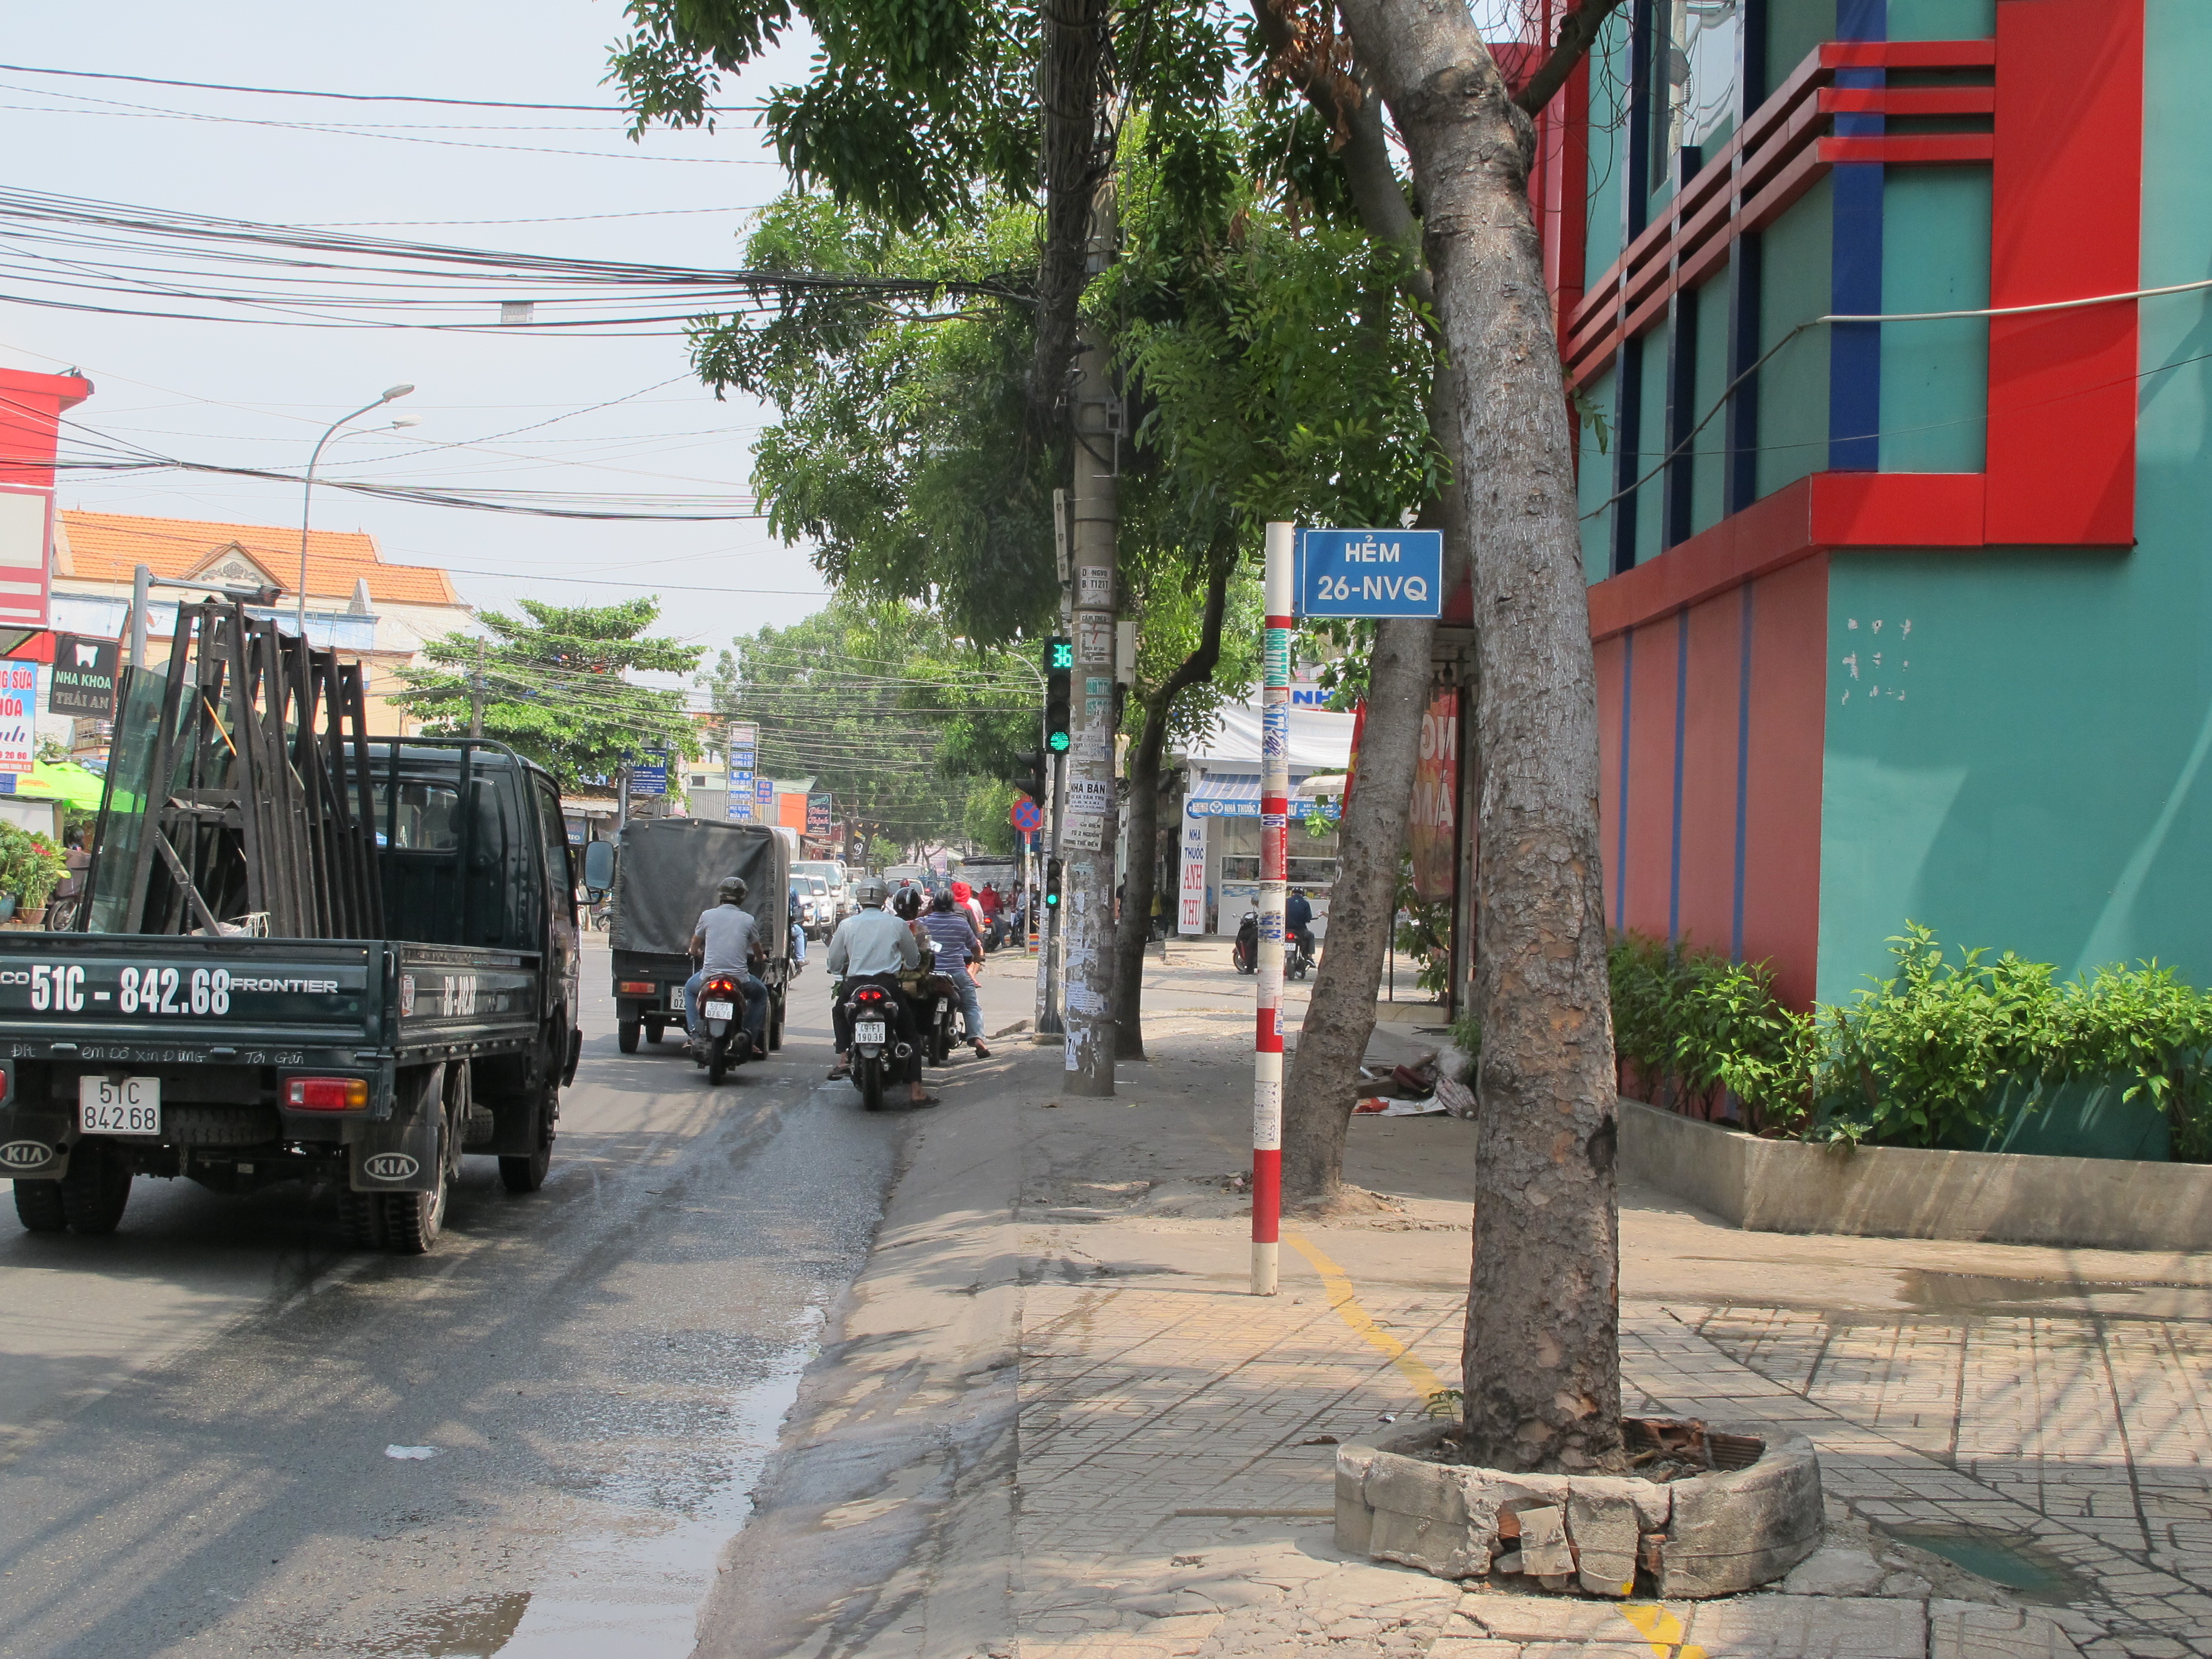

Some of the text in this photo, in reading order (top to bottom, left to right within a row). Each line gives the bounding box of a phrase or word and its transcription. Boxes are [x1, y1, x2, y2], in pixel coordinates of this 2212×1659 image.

[1346, 535, 1400, 562] HẺM
[1318, 575, 1427, 602] 26-NVQ
[1053, 644, 1072, 668] 36
[56, 671, 113, 690] NHA KHOA
[56, 690, 110, 709] THÁI AN
[1071, 781, 1105, 794] NHÀ BÁN
[1224, 802, 1236, 814] NHÀ
[1238, 801, 1256, 814] THUỐC
[1189, 826, 1201, 841] NHÀ
[1184, 842, 1204, 860] THUỐC
[1184, 864, 1203, 890] ANH
[1183, 895, 1202, 925] THƯ
[32, 965, 85, 1011] 51C
[120, 967, 230, 1015] 842.68
[230, 978, 338, 993] FRONTIER
[858, 1033, 883, 1042] 190.36
[82, 1047, 104, 1059] em
[100, 1081, 140, 1104] 51C
[84, 1106, 156, 1130] 842.68
[7, 1147, 44, 1162] KIA
[375, 1159, 410, 1174] KIA
